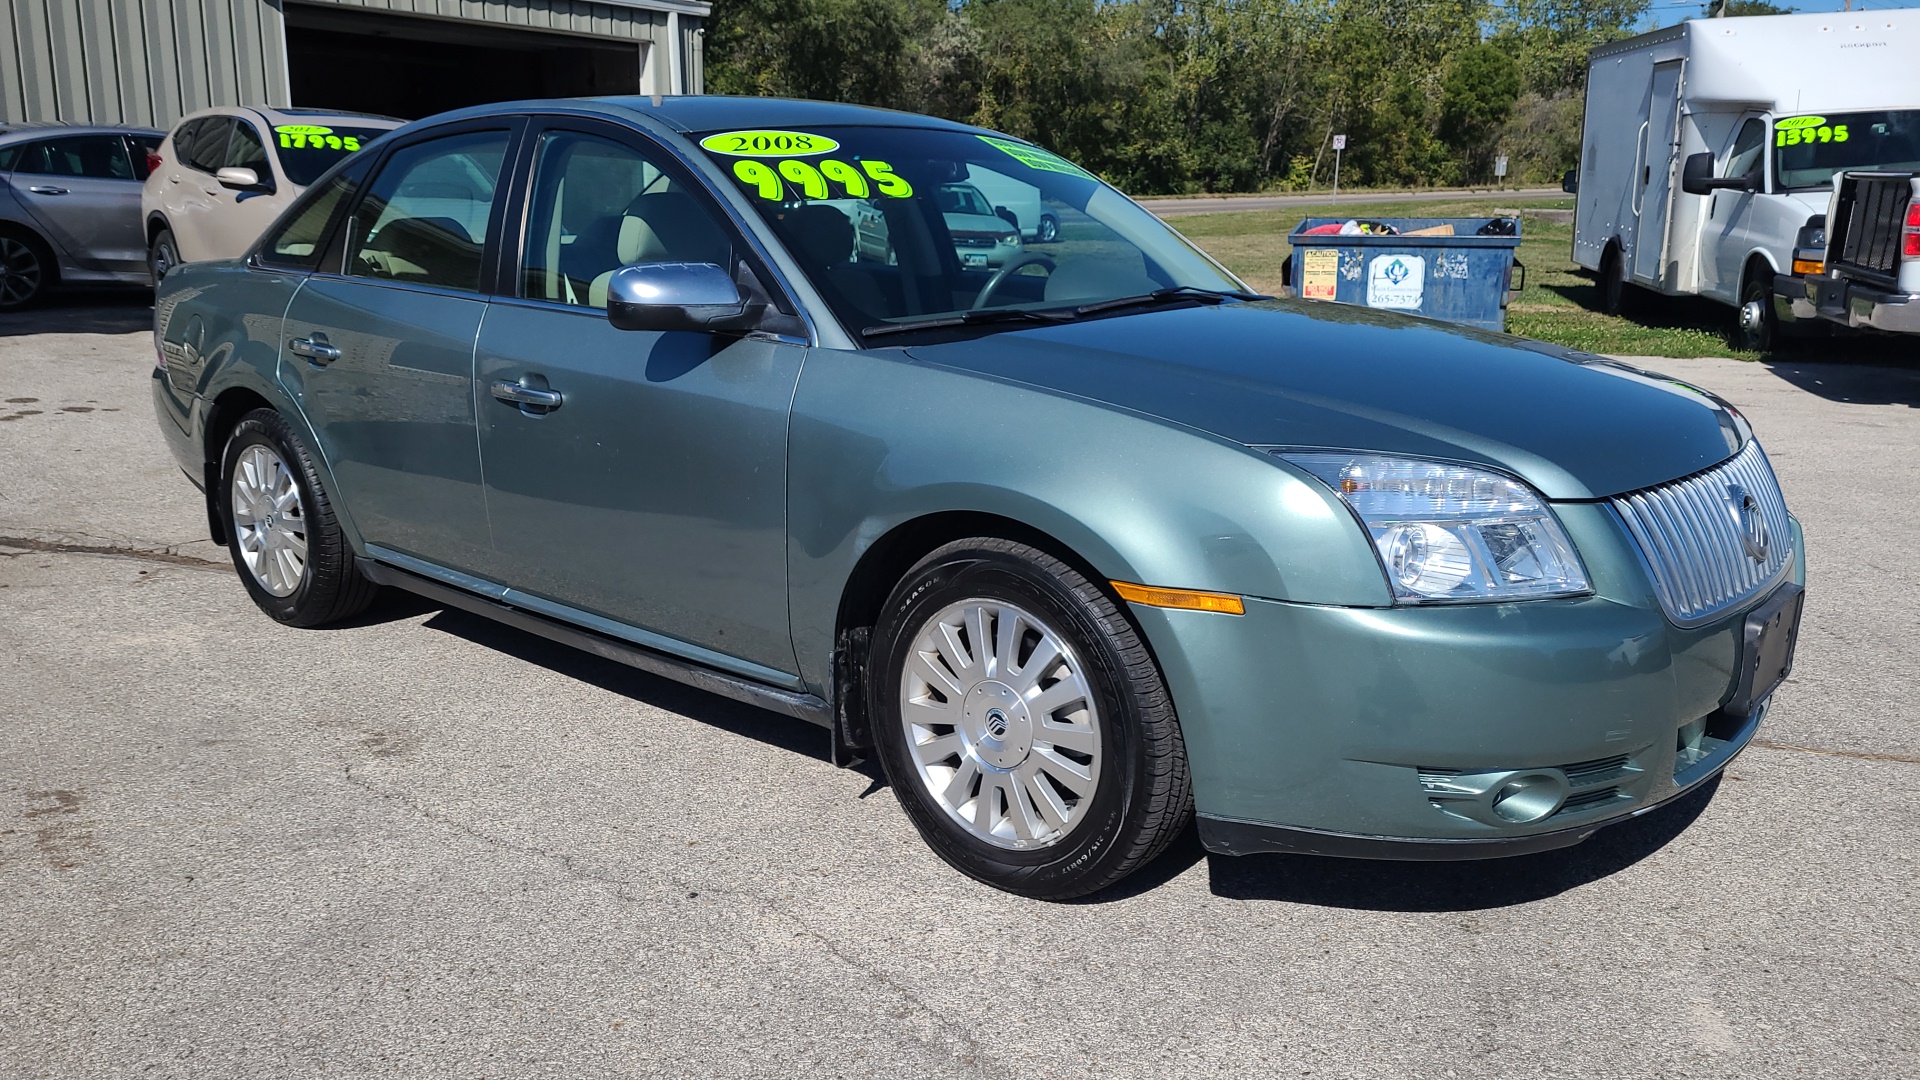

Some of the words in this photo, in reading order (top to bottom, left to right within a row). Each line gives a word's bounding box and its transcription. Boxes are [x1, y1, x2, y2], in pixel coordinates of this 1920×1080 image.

[279, 133, 361, 152] 17995
[730, 135, 813, 151] 2008
[1776, 125, 1849, 147] 13995
[733, 159, 913, 202] 9995
